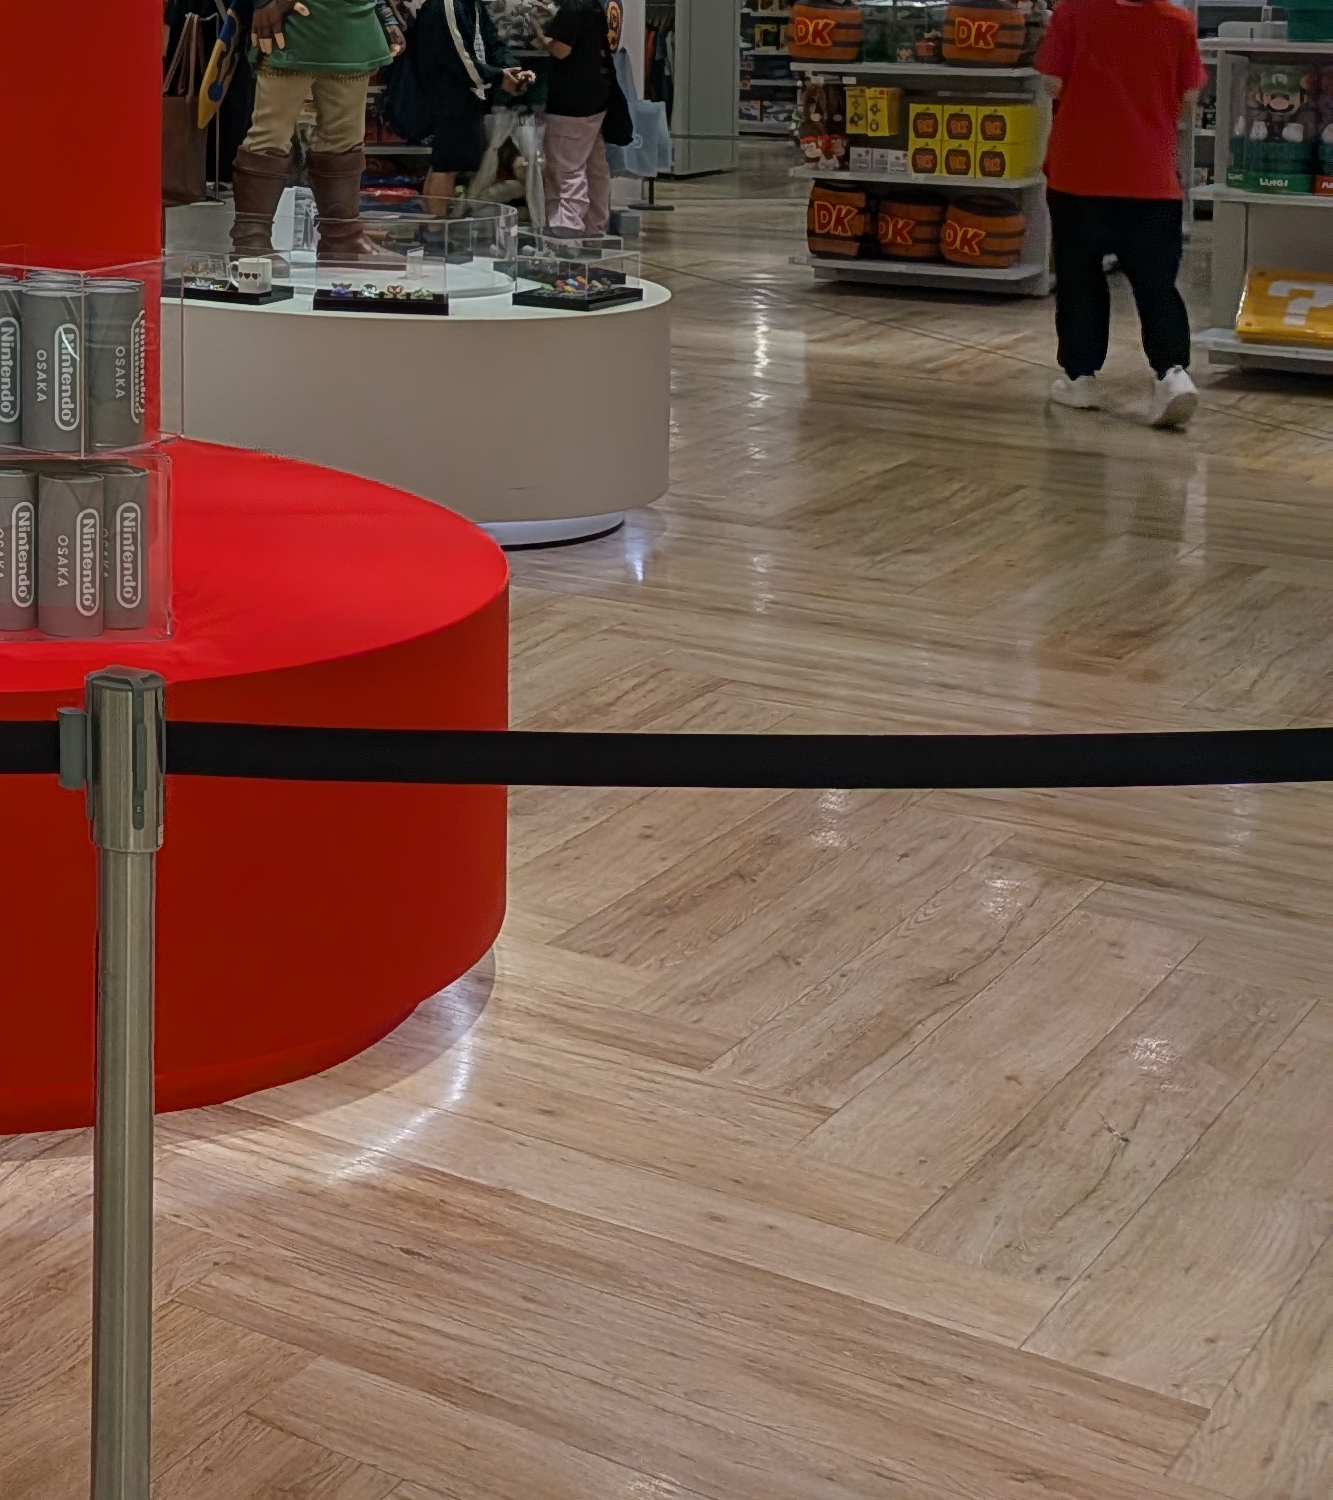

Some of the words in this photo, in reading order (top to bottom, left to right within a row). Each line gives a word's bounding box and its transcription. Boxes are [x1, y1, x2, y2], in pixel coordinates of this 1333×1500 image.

[795, 17, 836, 47] DK
[955, 17, 999, 49] DK
[814, 201, 858, 236] DK
[944, 219, 986, 256] DK
[36, 349, 47, 402] OSAKA
[115, 346, 126, 399] OSAKA
[57, 534, 69, 588] OSAKA
